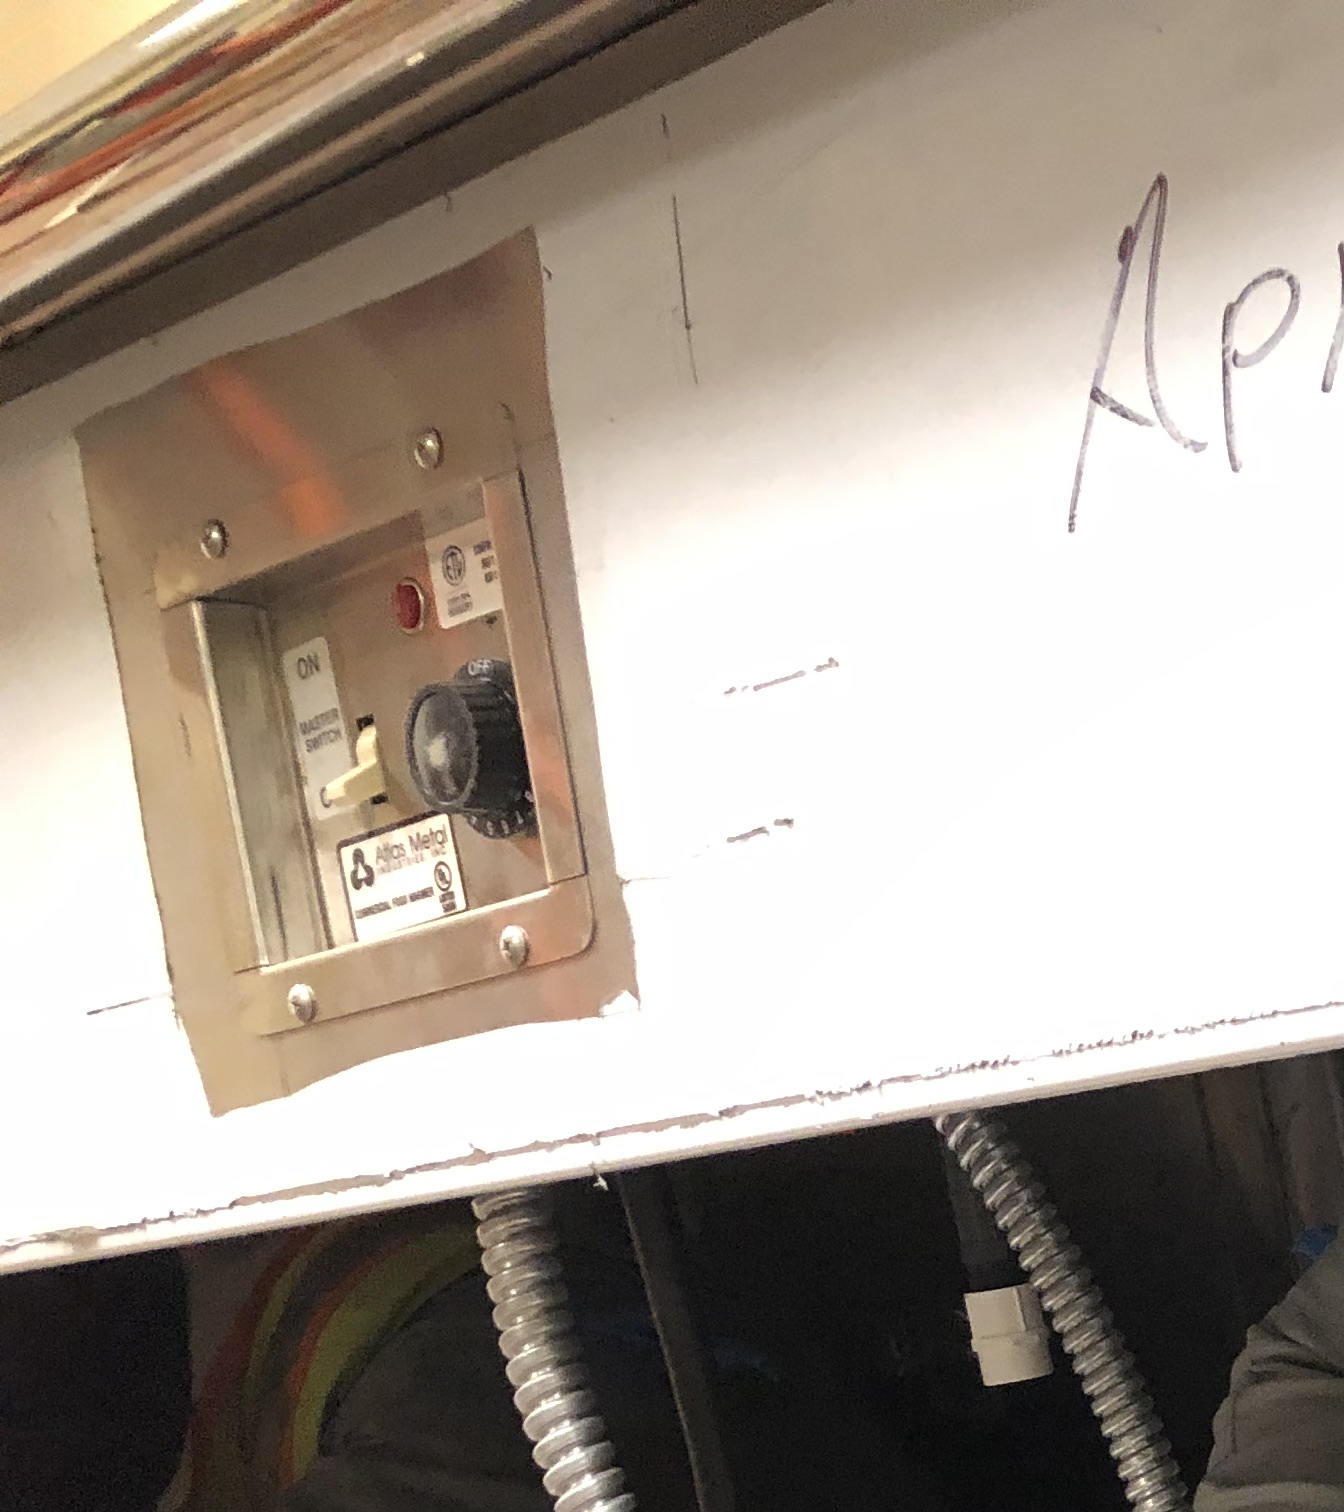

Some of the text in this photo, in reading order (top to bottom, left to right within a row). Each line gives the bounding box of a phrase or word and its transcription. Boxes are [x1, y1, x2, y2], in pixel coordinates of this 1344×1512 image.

[296, 652, 321, 681] ON
[468, 658, 493, 677] OFF
[304, 727, 343, 754] SWITCH
[376, 841, 406, 863] Atlas
[409, 824, 448, 852] Metal
